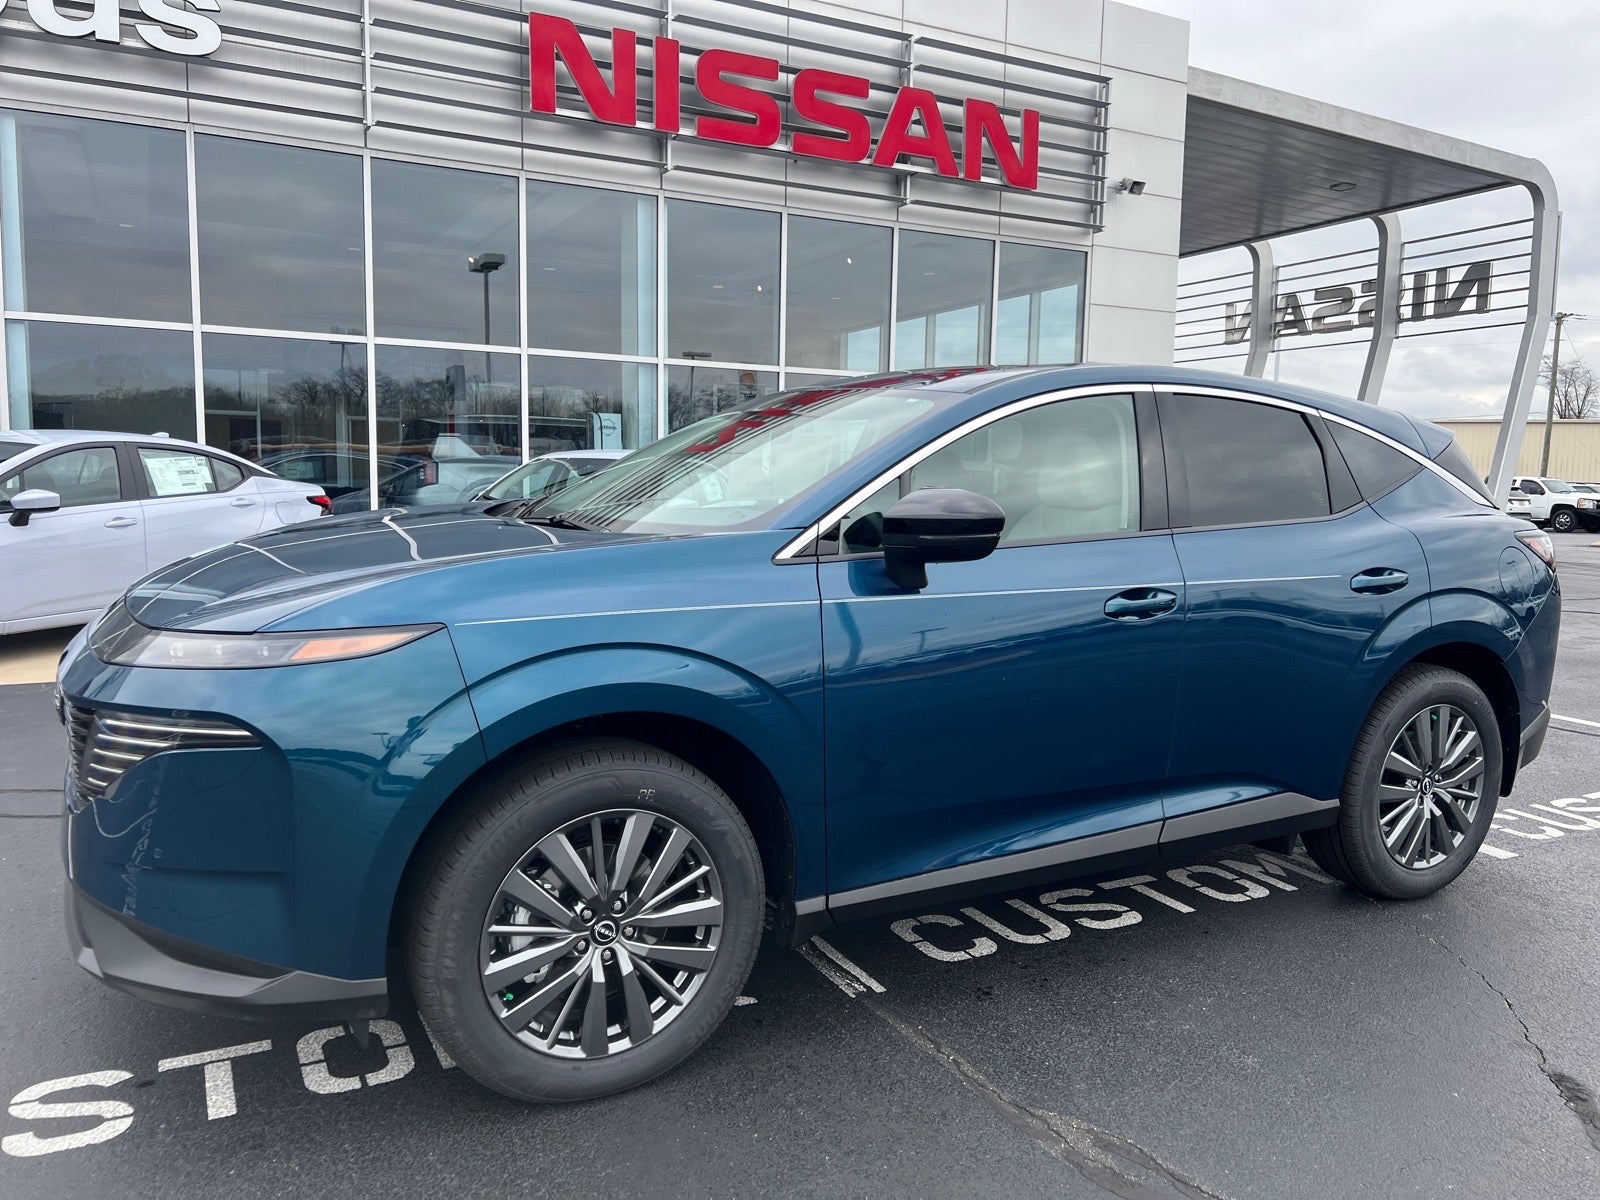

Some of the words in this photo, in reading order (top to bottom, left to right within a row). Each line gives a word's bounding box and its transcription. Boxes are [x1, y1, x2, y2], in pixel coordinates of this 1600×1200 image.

[529, 12, 1040, 190] NISSAN
[1487, 791, 1600, 840] CUS
[891, 846, 1340, 962] CUSTOM
[2, 1016, 458, 1157] STO
